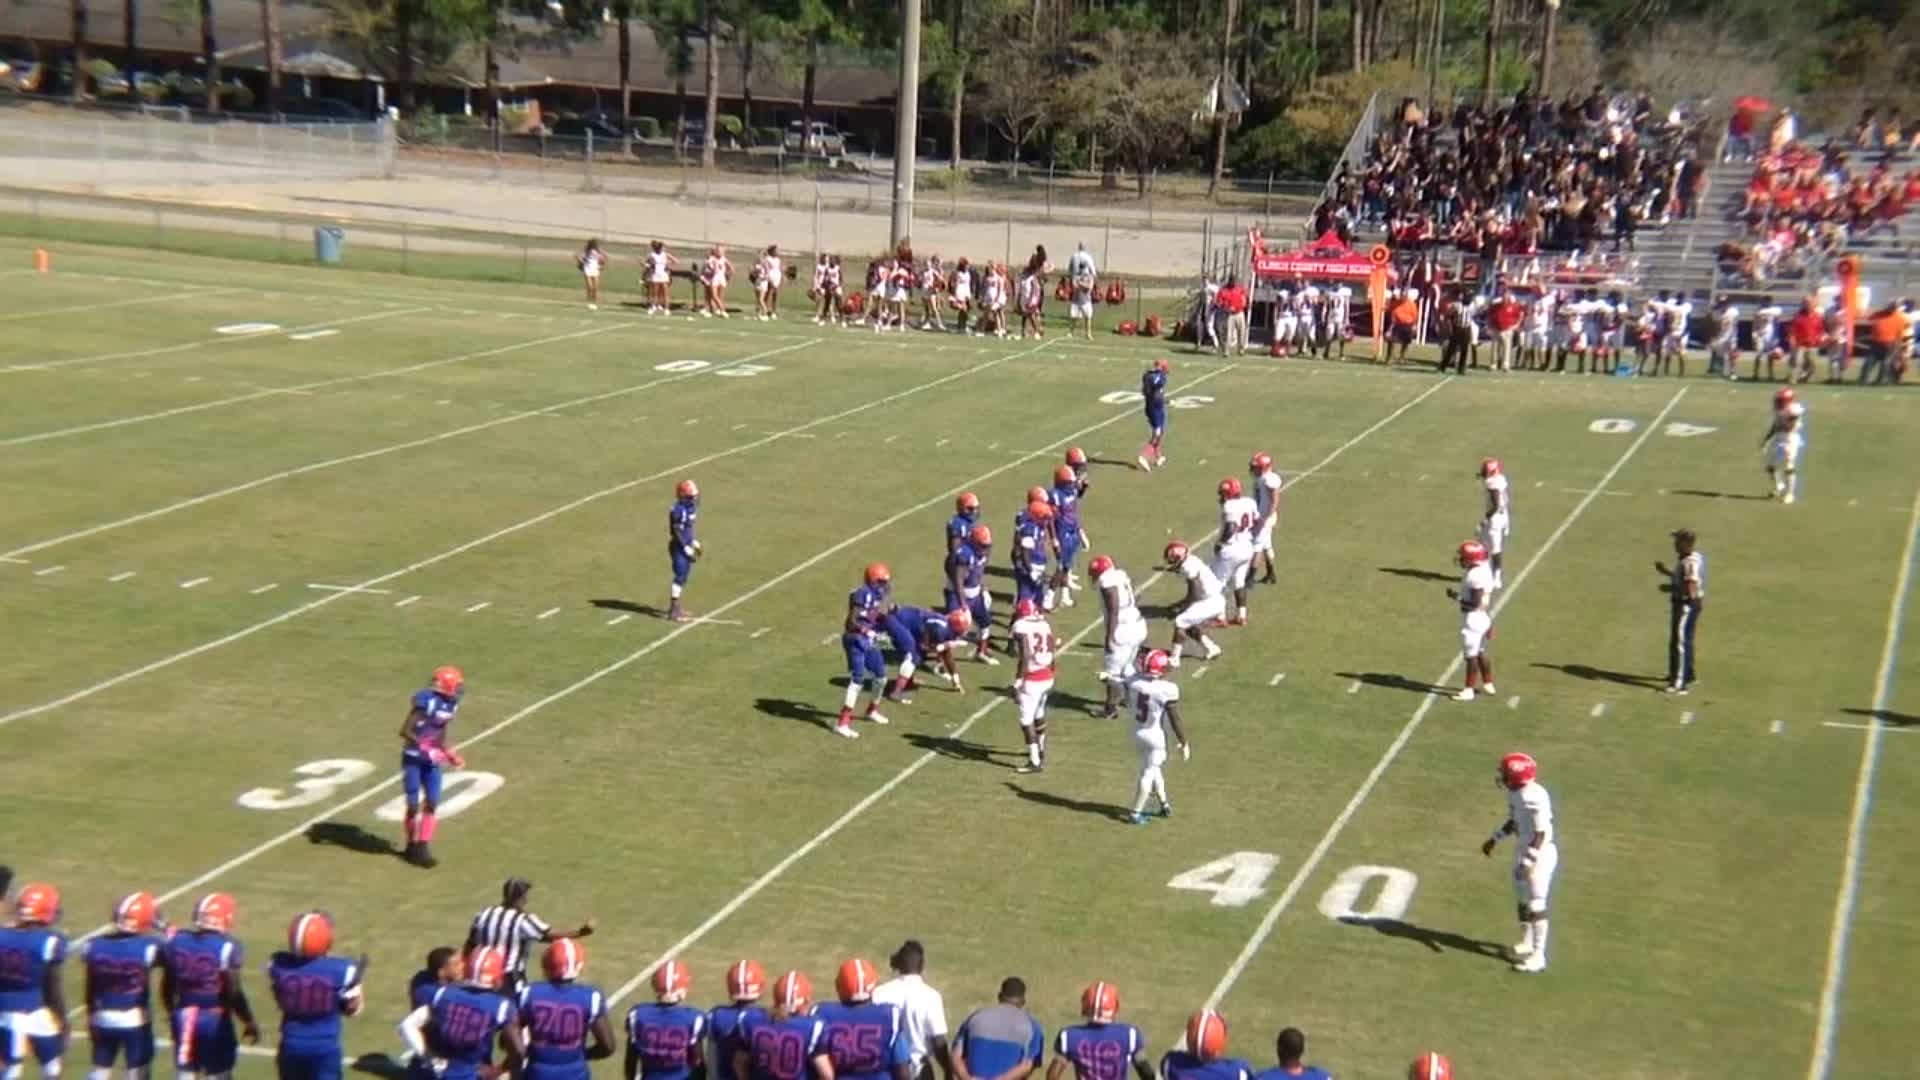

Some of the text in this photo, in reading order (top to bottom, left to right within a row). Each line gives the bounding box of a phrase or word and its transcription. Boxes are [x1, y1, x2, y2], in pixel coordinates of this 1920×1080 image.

[1291, 262, 1326, 272] COUNTY
[1327, 263, 1347, 274] HIGH
[235, 757, 506, 822] 30
[1165, 850, 1419, 922] 40
